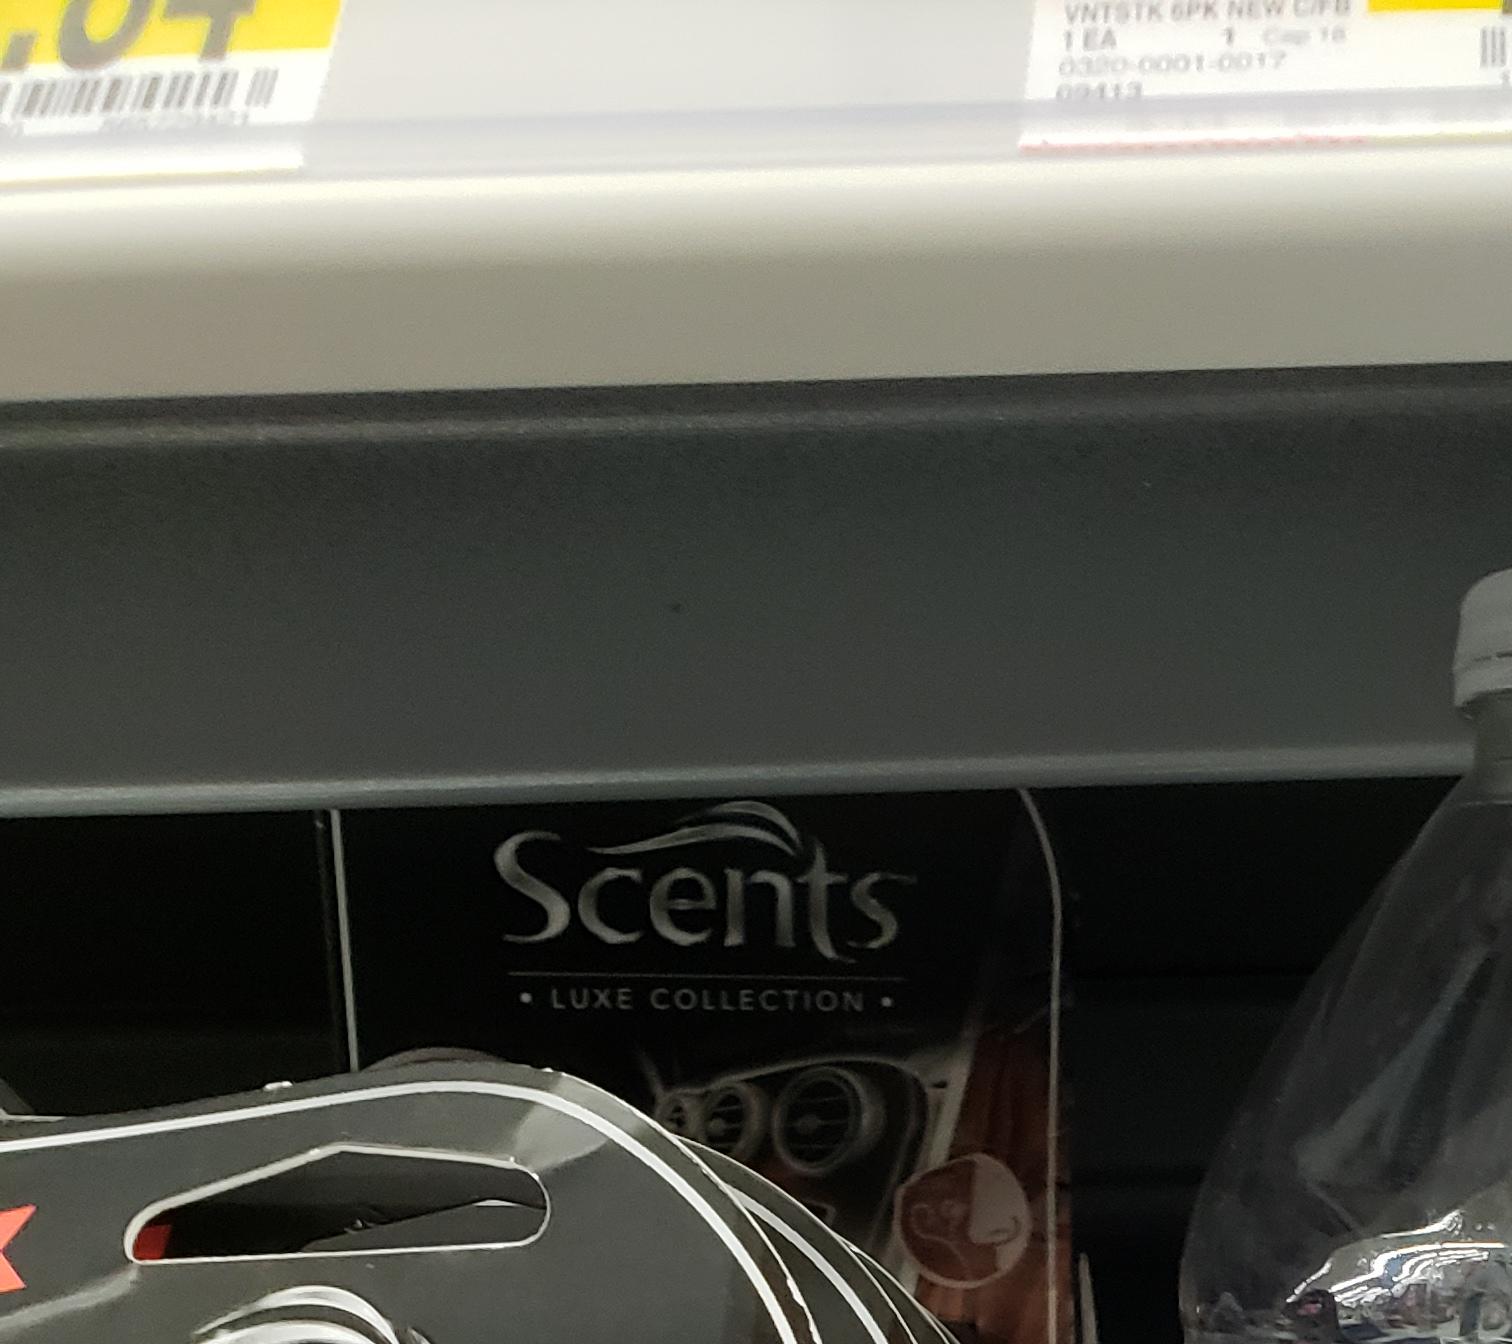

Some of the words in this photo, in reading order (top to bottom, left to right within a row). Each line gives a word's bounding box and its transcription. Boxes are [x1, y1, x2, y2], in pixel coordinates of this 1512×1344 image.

[494, 831, 916, 963] Scents
[551, 986, 633, 1011] LUXE
[650, 986, 865, 1013] COLLECTION
